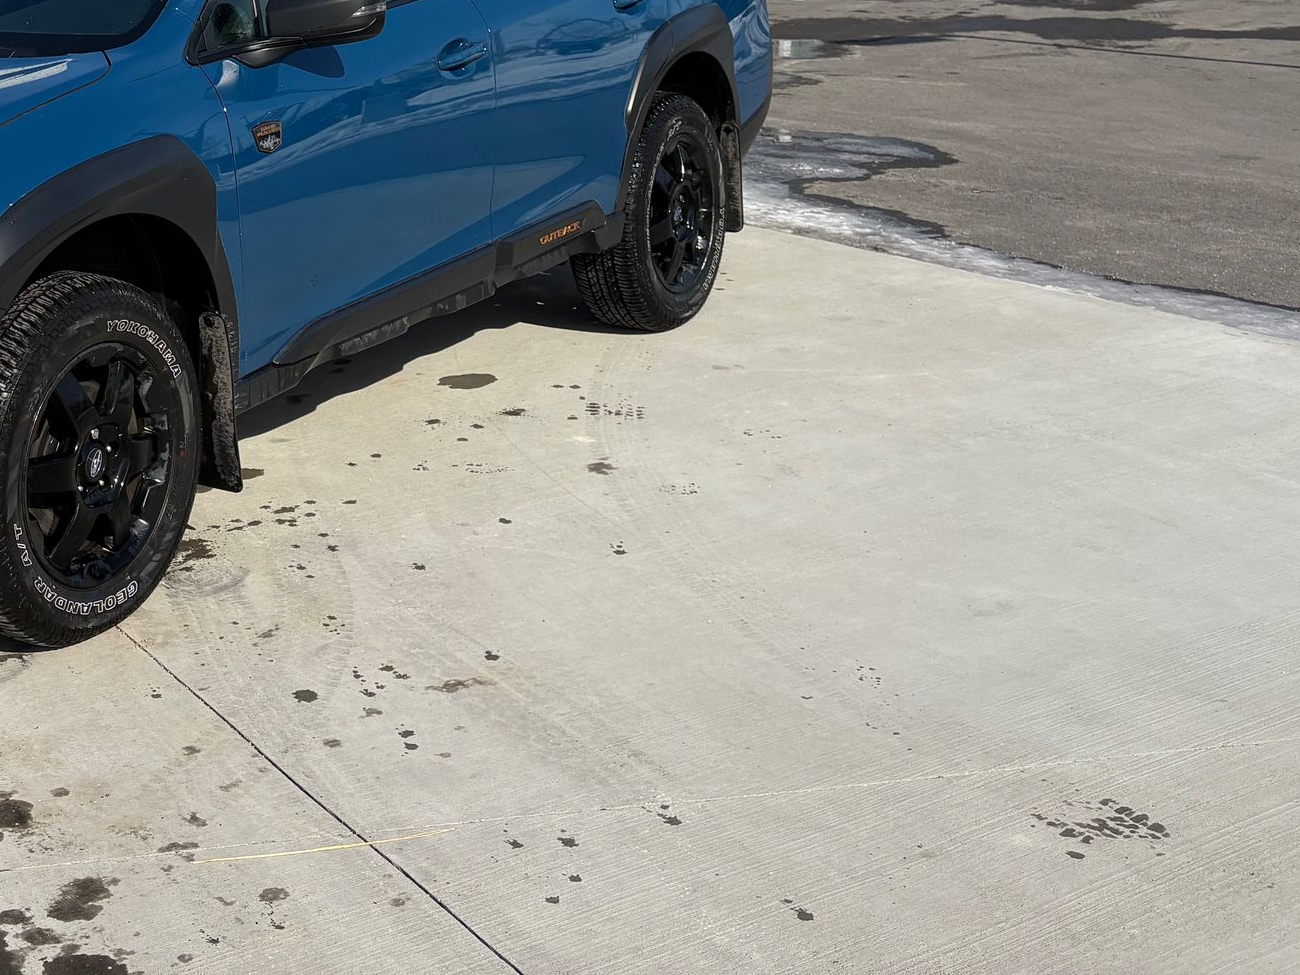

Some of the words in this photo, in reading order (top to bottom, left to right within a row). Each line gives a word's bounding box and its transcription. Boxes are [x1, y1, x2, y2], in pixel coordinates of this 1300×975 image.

[539, 220, 581, 245] OUTBACK
[106, 319, 182, 379] YOKOHAMA
[33, 576, 139, 615] GEOLANDAR
